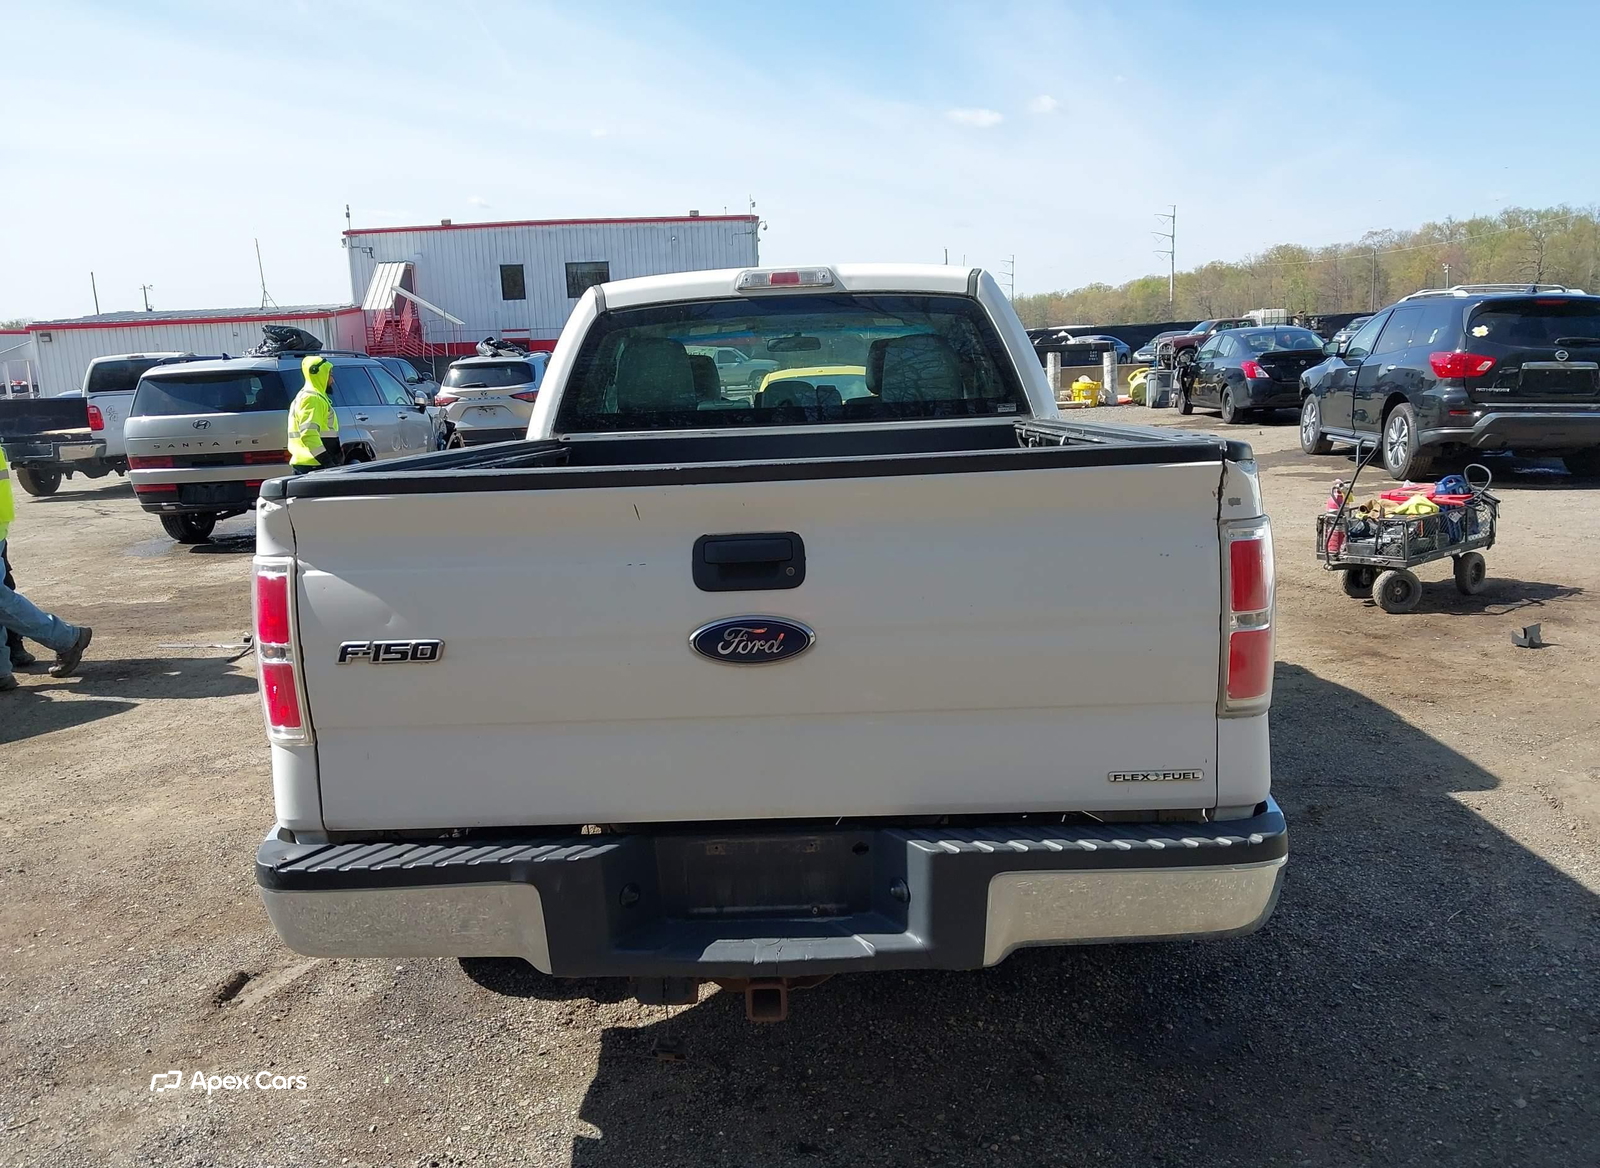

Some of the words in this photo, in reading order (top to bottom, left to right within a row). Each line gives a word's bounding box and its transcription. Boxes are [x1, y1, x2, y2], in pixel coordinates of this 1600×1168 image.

[153, 441, 220, 450] SANTA
[717, 627, 785, 655] Ford
[336, 639, 445, 665] F-150
[1113, 773, 1151, 781] FLEX
[1162, 771, 1200, 780] FUEL
